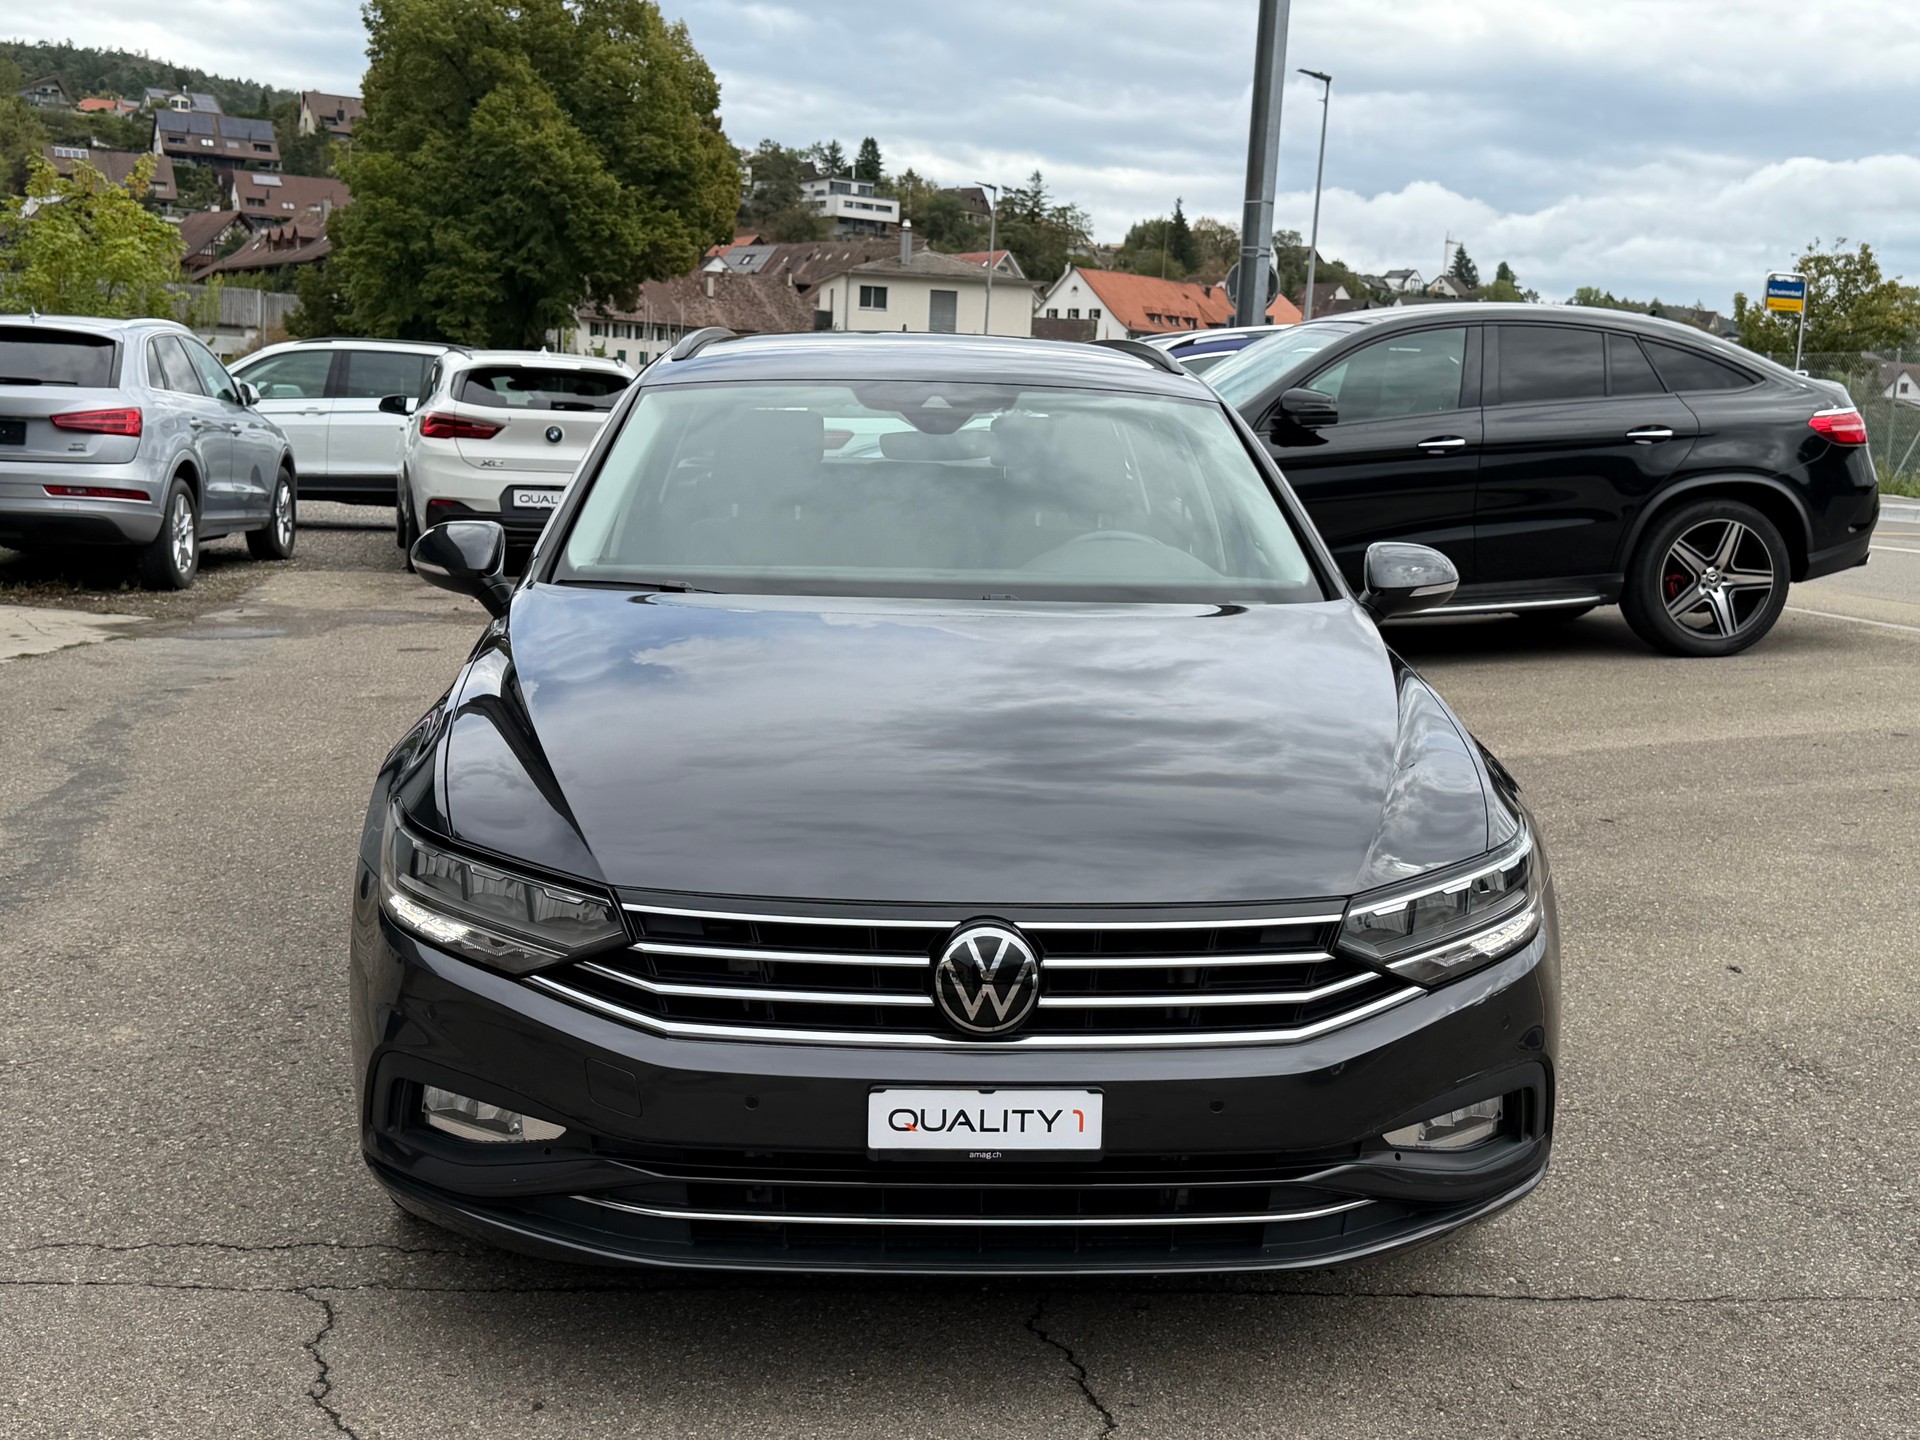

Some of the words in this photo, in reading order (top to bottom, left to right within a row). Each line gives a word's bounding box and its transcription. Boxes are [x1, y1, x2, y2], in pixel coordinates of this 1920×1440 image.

[941, 931, 1034, 1024] VW
[888, 1108, 1063, 1133] QUALITY
[1072, 1109, 1084, 1133] 1
[969, 1151, 1002, 1159] amag.ch
